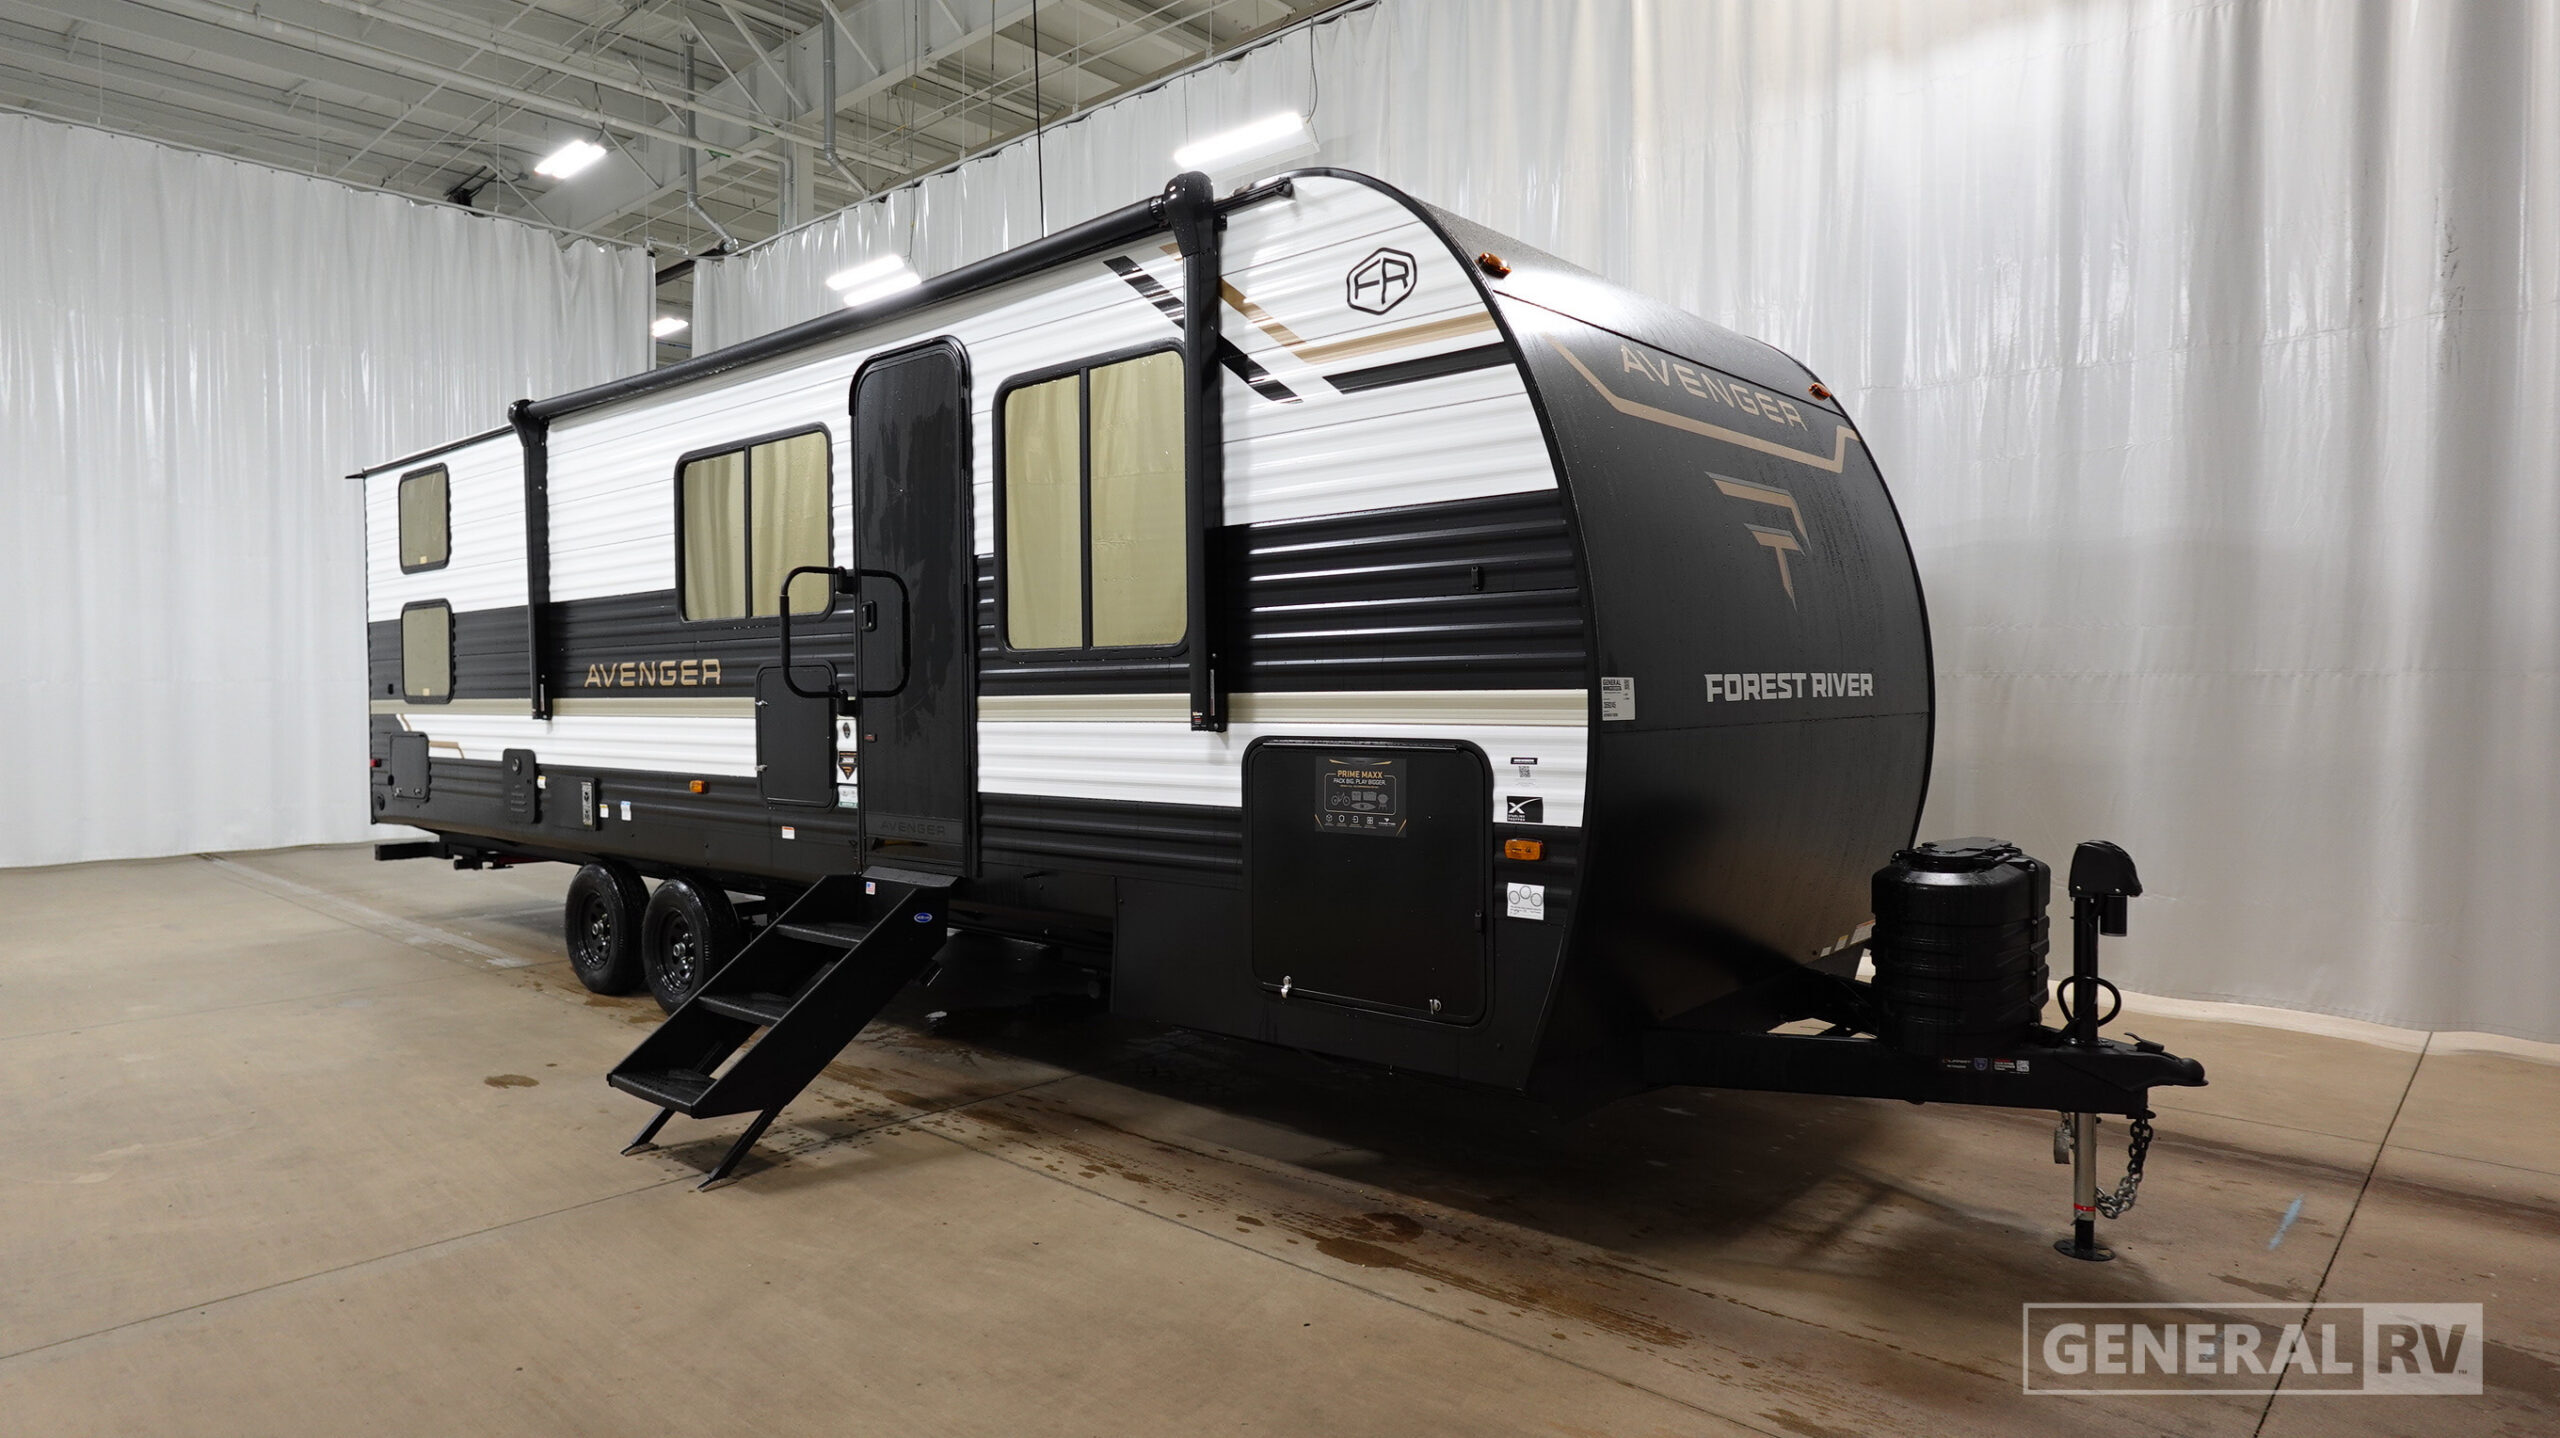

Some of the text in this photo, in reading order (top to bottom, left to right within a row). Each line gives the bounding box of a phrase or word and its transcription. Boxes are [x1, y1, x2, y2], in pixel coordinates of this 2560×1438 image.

[1620, 343, 1809, 432] AVENGER
[584, 658, 721, 688] AVENGER
[1704, 672, 1874, 703] FOREST RIVER
[1337, 769, 1383, 779] PRIME MAXX
[880, 821, 945, 836] AVENGER
